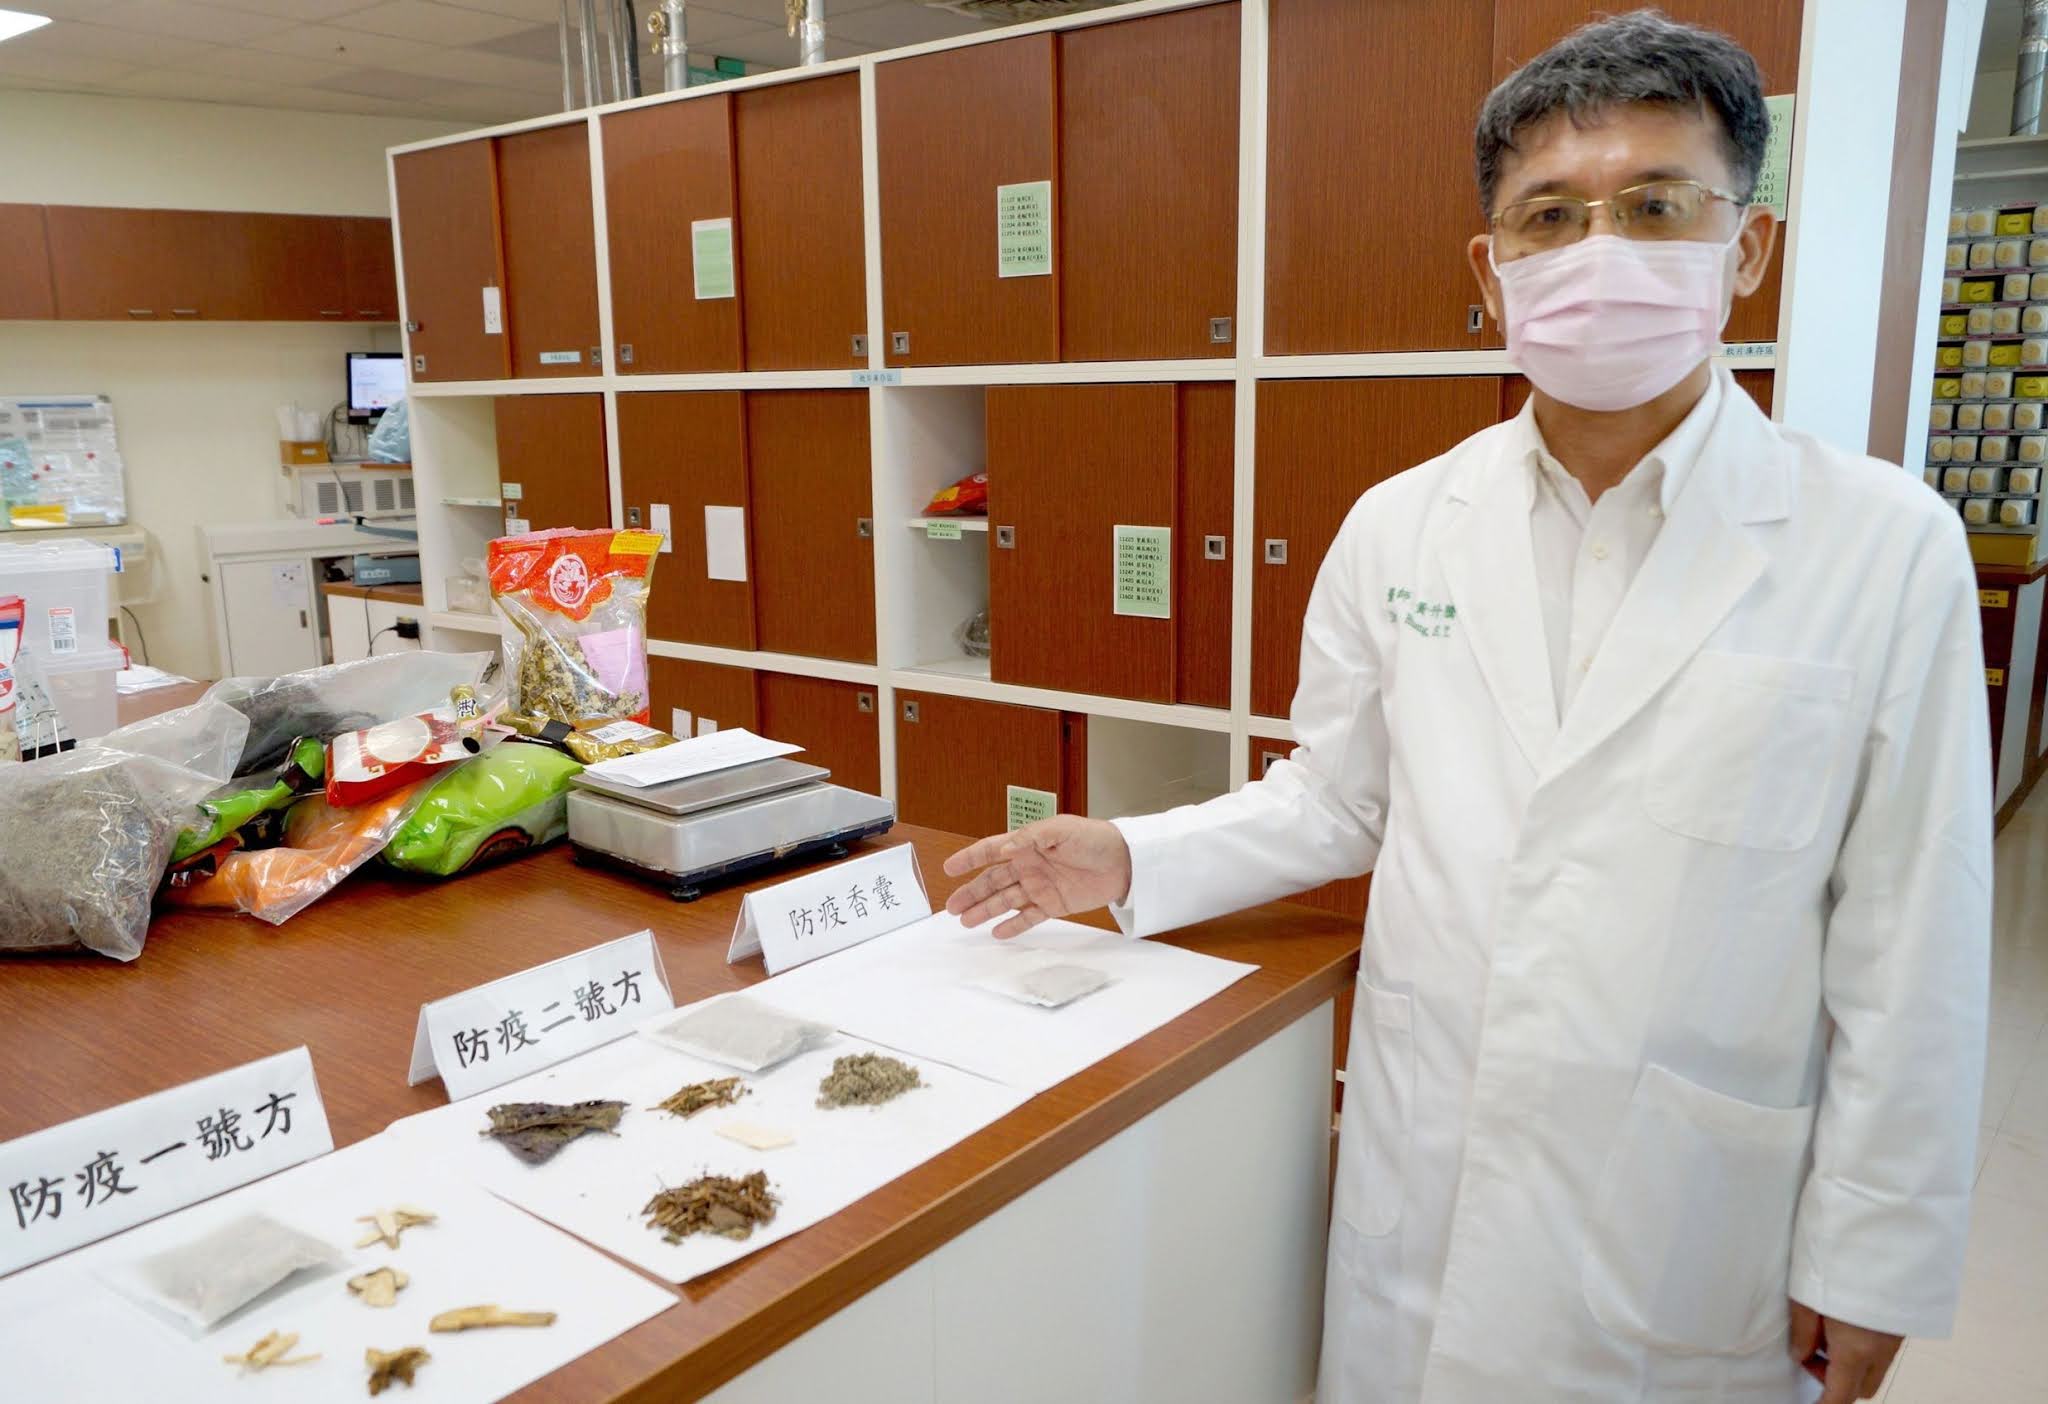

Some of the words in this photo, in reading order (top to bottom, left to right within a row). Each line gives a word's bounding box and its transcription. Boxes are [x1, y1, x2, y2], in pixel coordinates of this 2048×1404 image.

[788, 874, 901, 940] 防疫香囊
[452, 970, 642, 1069] 防疫二號方
[9, 1093, 297, 1230] 防疫一號方
